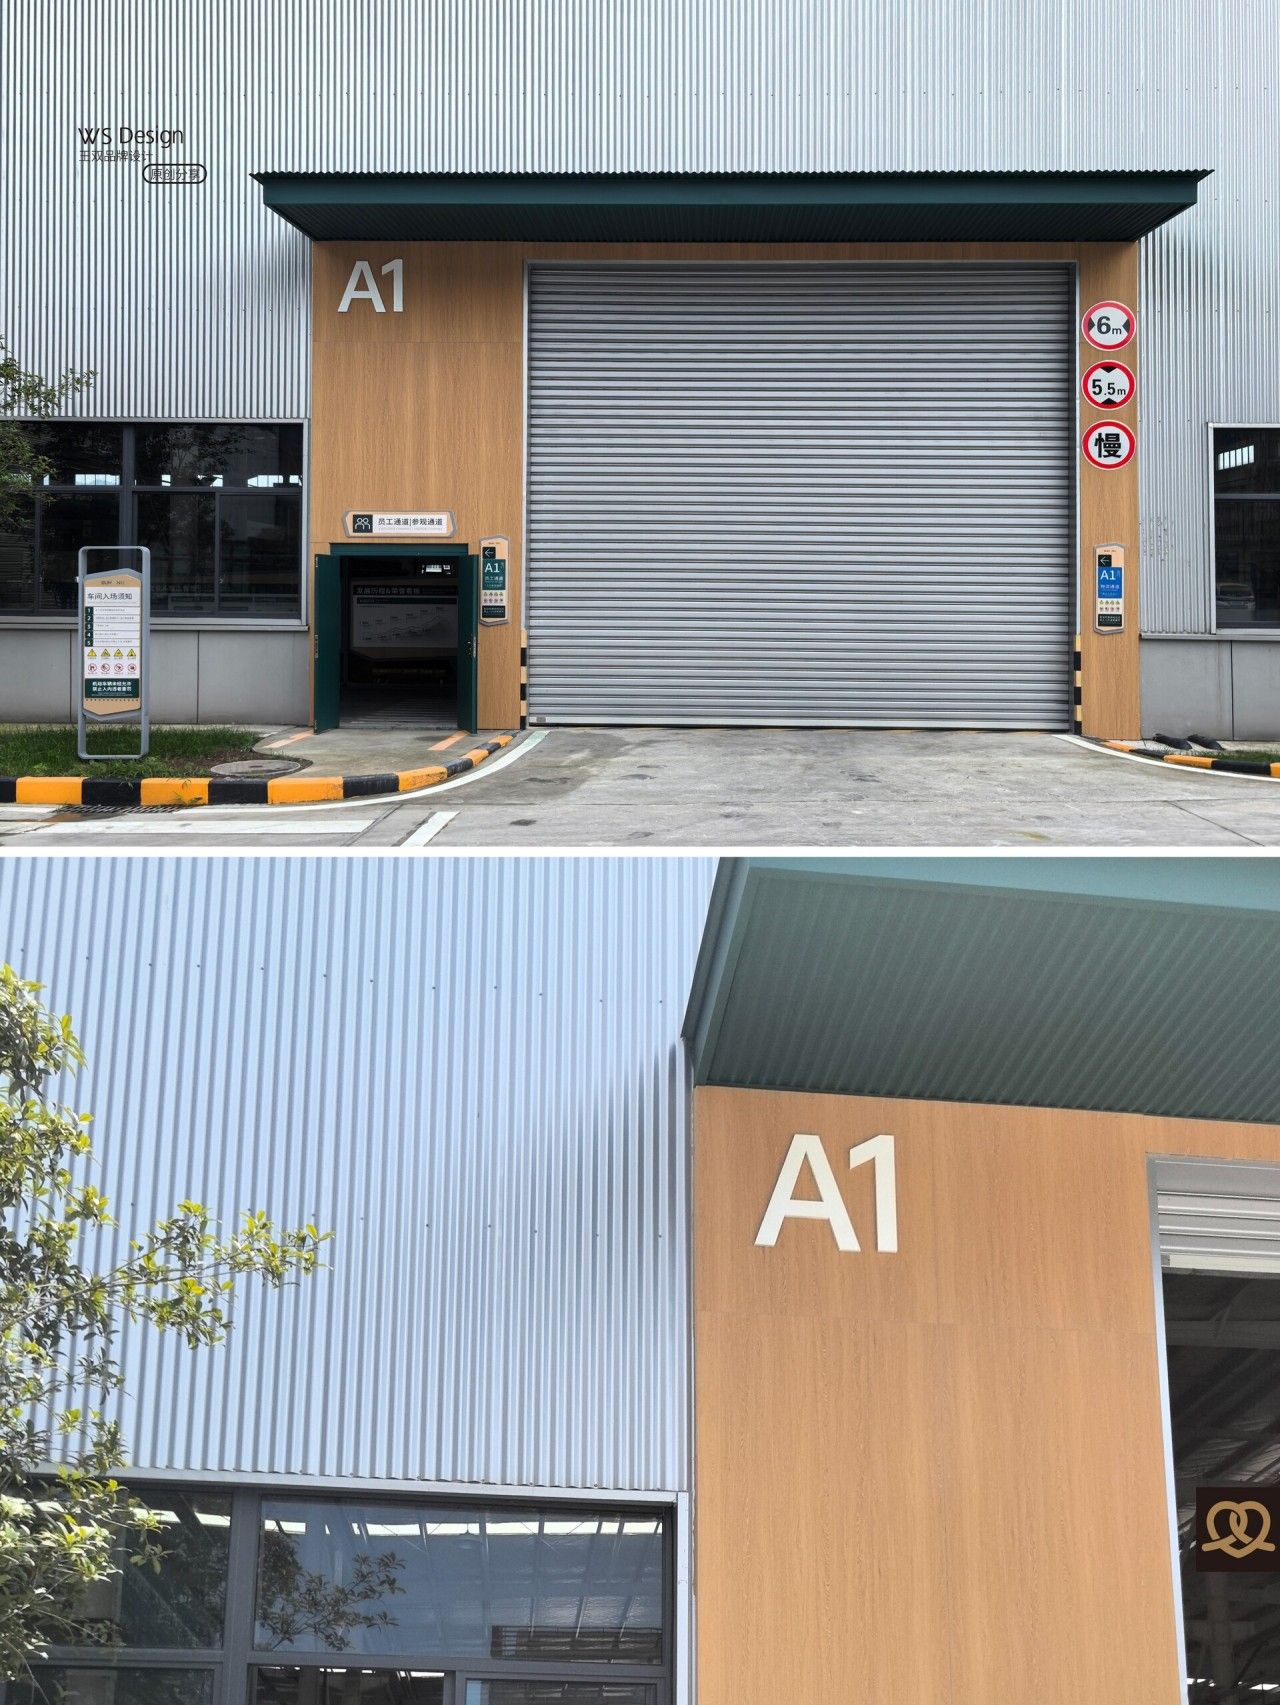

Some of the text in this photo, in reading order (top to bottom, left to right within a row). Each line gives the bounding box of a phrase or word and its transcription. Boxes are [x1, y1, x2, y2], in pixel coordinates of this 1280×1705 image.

[338, 258, 404, 313] A1
[1096, 315, 1122, 336] 6m
[1092, 378, 1127, 397] 5.5m
[1094, 432, 1122, 459] 慢
[484, 562, 501, 573] A1
[1100, 569, 1117, 581] A1
[87, 592, 133, 600] 车间入场须知
[754, 1133, 899, 1254] A1
